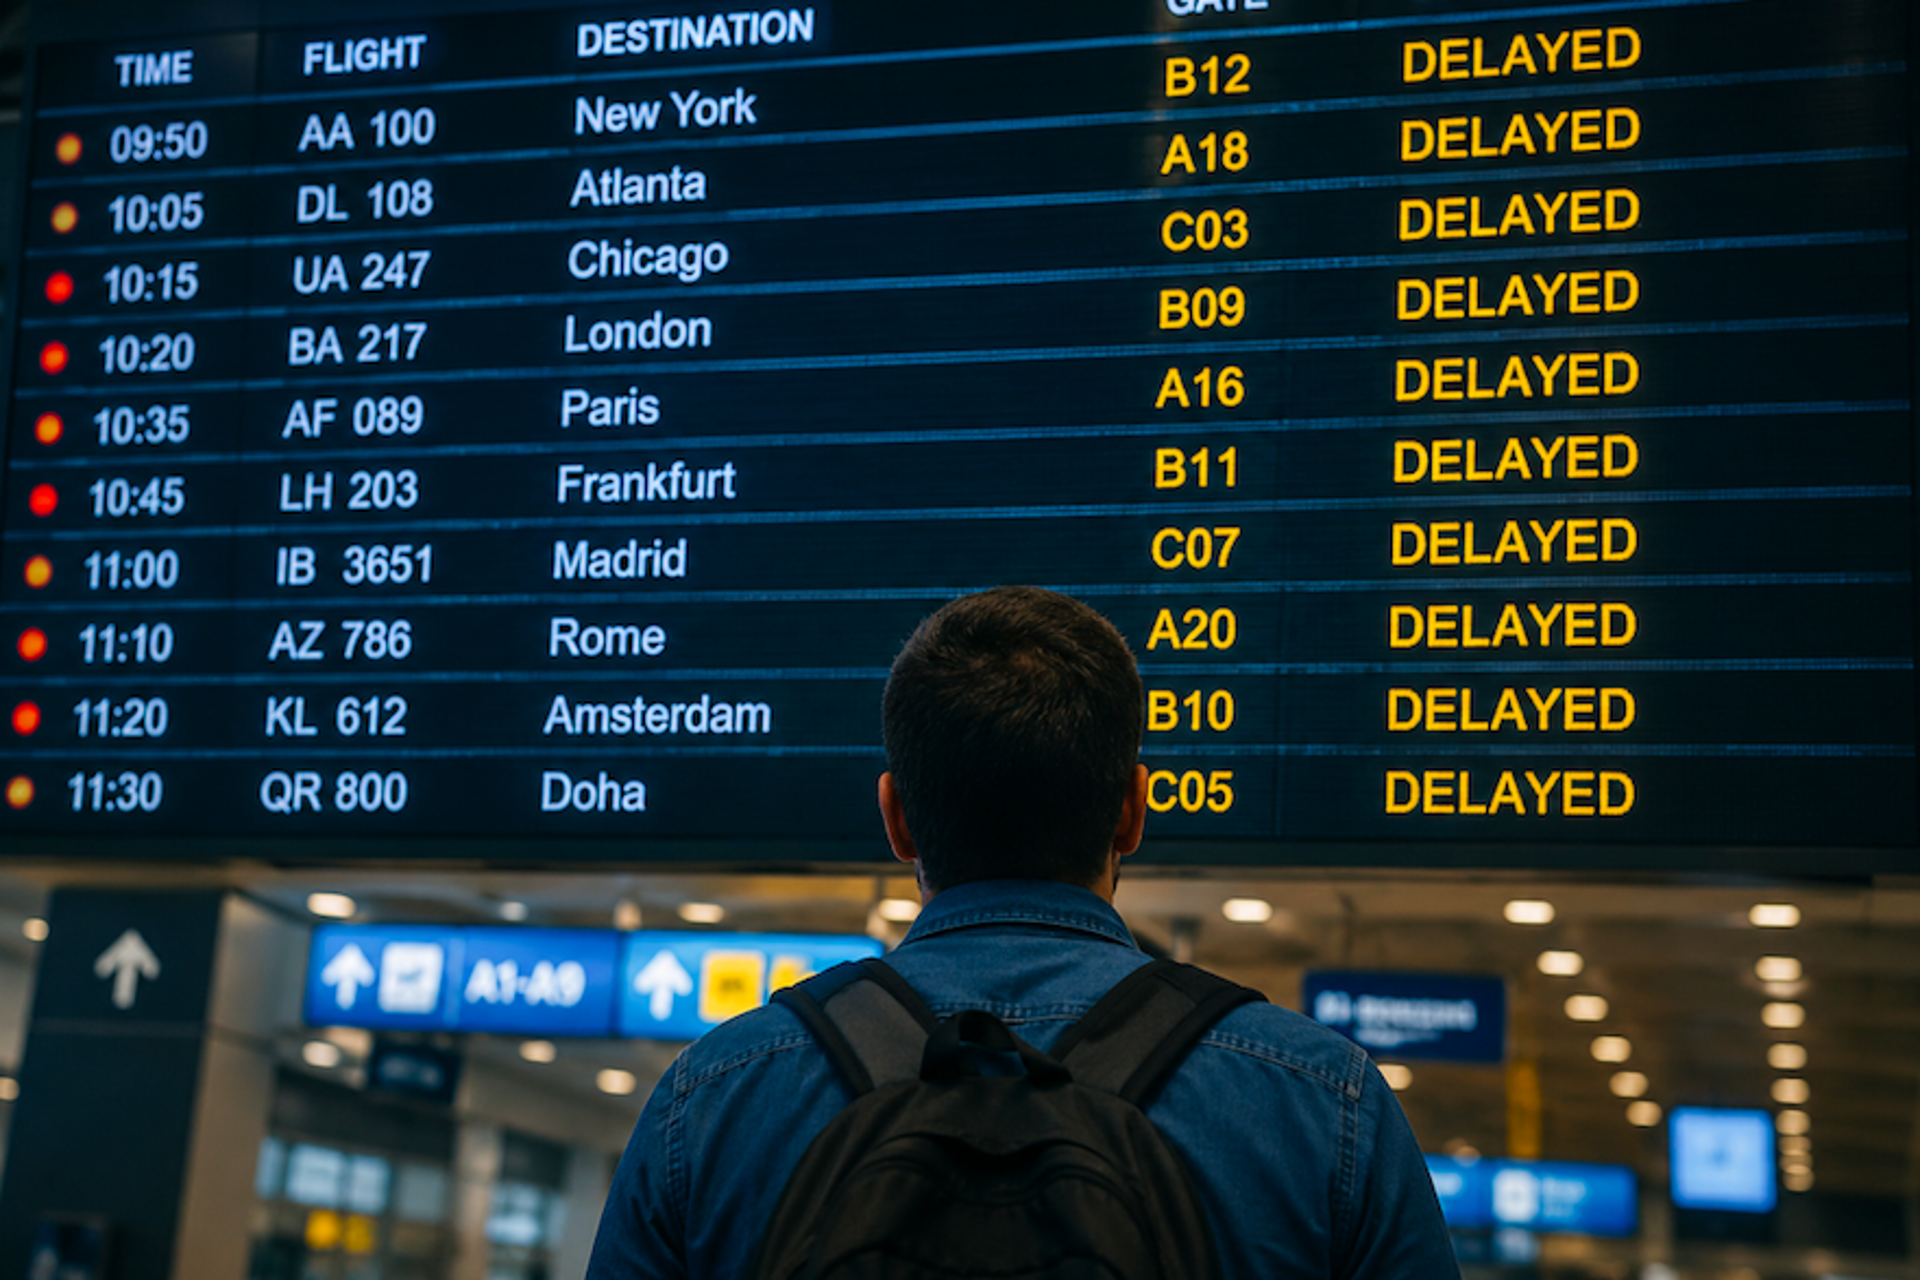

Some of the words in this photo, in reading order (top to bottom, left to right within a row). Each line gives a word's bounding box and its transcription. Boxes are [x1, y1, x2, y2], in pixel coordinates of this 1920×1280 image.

[577, 8, 814, 57] DESTINATION
[116, 50, 193, 86] TIME
[304, 35, 426, 74] FLIGHT
[1165, 53, 1251, 98] B12
[1403, 26, 1642, 83] DELAYED
[299, 114, 354, 151] AA
[372, 108, 435, 146] 100
[575, 96, 662, 134] New
[670, 87, 757, 127] York
[110, 121, 208, 163] 09:50
[1160, 130, 1249, 175] A18
[1400, 107, 1641, 162] DELAYED
[297, 185, 348, 222] DL
[369, 179, 433, 218] 108
[570, 166, 706, 207] Atlanta
[110, 191, 204, 232] 10:05
[1161, 208, 1250, 252] C03
[1398, 188, 1640, 242] DELAYED
[104, 261, 199, 302] 10:15
[294, 255, 349, 294] UA
[361, 250, 430, 290] 247
[568, 238, 729, 283] Chicago
[1158, 285, 1246, 330] B09
[1396, 269, 1640, 321] DELAYED
[99, 333, 195, 372] 10:20
[289, 326, 343, 365] BA
[357, 322, 427, 362] 217
[565, 310, 712, 353] London
[1154, 365, 1245, 409] A16
[1395, 351, 1640, 402] DELAYED
[94, 404, 190, 445] 10:35
[282, 398, 337, 437] AF
[353, 395, 424, 435] 089
[561, 386, 660, 428] Paris
[1154, 446, 1237, 489] B11
[1393, 433, 1639, 483] DELAYED
[89, 476, 185, 516] 10:45
[280, 472, 333, 511] LH
[348, 469, 418, 509] 203
[557, 460, 736, 503] Frankfurt
[553, 538, 687, 579] Madrid
[1151, 526, 1241, 570] C07
[1391, 517, 1638, 566] DELAYED
[84, 549, 179, 589] 11:00
[277, 547, 315, 585] IB
[343, 544, 433, 584] 3651
[78, 623, 174, 663] 11:10
[268, 621, 325, 660] AZ
[342, 620, 412, 659] 786
[549, 617, 666, 656] Rome
[1146, 607, 1237, 651] A20
[1389, 602, 1637, 648] DELAYED
[73, 697, 168, 737] 11:20
[265, 696, 317, 735] KL
[337, 696, 407, 736] 612
[543, 693, 771, 734] Amsterdam
[1147, 689, 1234, 732] B10
[1387, 687, 1636, 732] DELAYED
[68, 772, 163, 811] 11:30
[260, 771, 322, 812] QR
[335, 772, 407, 811] 800
[541, 771, 646, 812] Doha
[1147, 769, 1234, 813] C05
[1385, 770, 1635, 816] DELAYED
